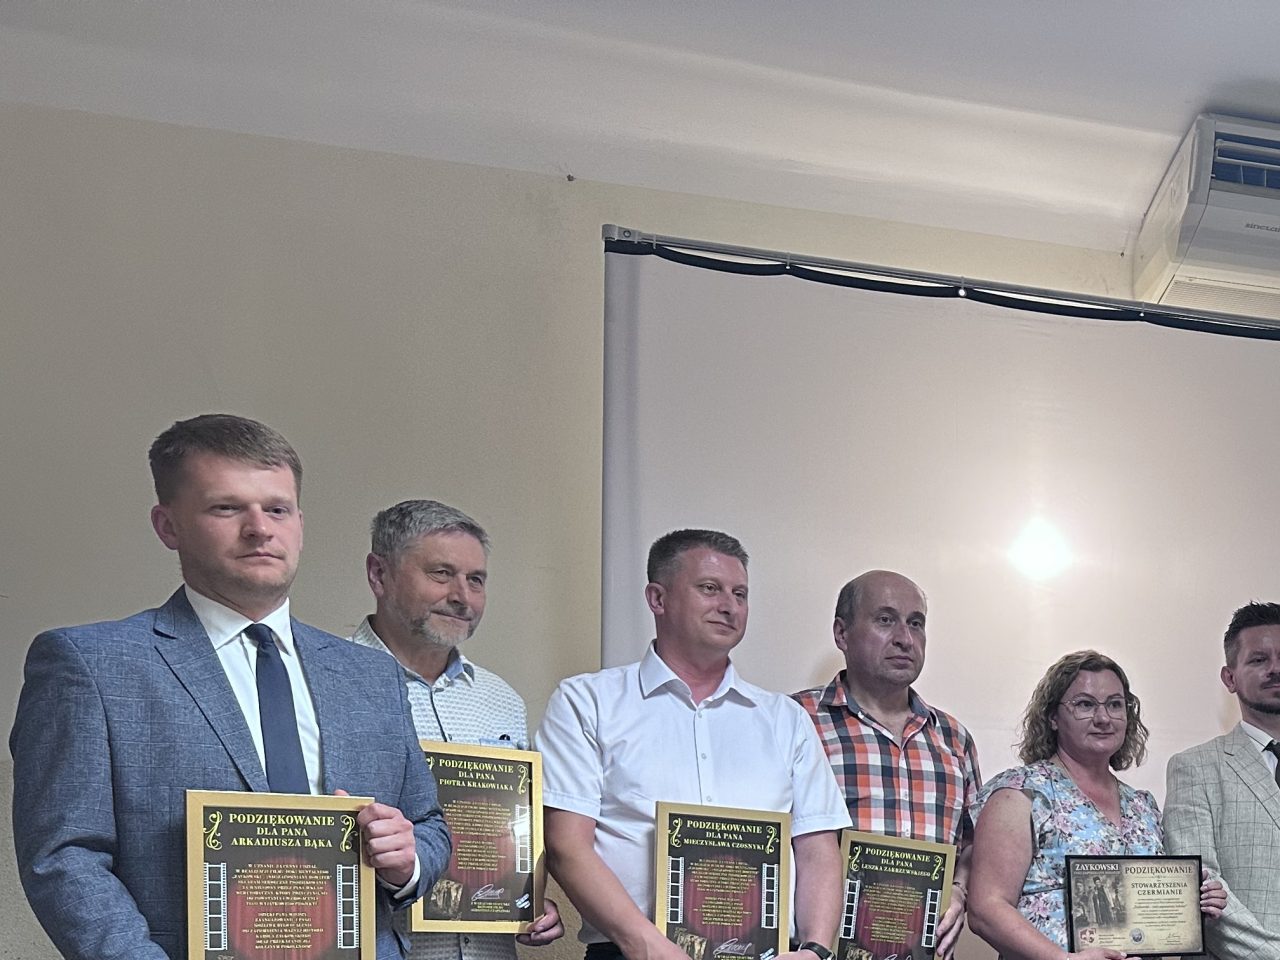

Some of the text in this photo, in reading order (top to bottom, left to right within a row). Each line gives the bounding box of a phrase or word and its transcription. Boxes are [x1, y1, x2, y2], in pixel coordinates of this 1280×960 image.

[439, 759, 514, 773] PODZIĘKOWANIE
[475, 772, 495, 780] PANA
[439, 779, 513, 791] PIOTRA KRAKOWIAKA
[229, 813, 335, 826] PODZIĘKOWANIE
[257, 827, 308, 837] DLA PANA
[686, 820, 763, 834] PODZIĘKOWANIE
[705, 831, 743, 841] DLA PANA
[231, 837, 333, 849] ARKADIUSZA BĄKA
[731, 842, 764, 850] CZOSNYKI
[865, 847, 931, 862] PODZIĘKOWANIE
[861, 863, 882, 871] LESZKA
[881, 858, 913, 868] DLA PANA
[1075, 863, 1119, 871] ZAYKOWSKI
[1125, 865, 1193, 875] PODZIĘKOWANIE
